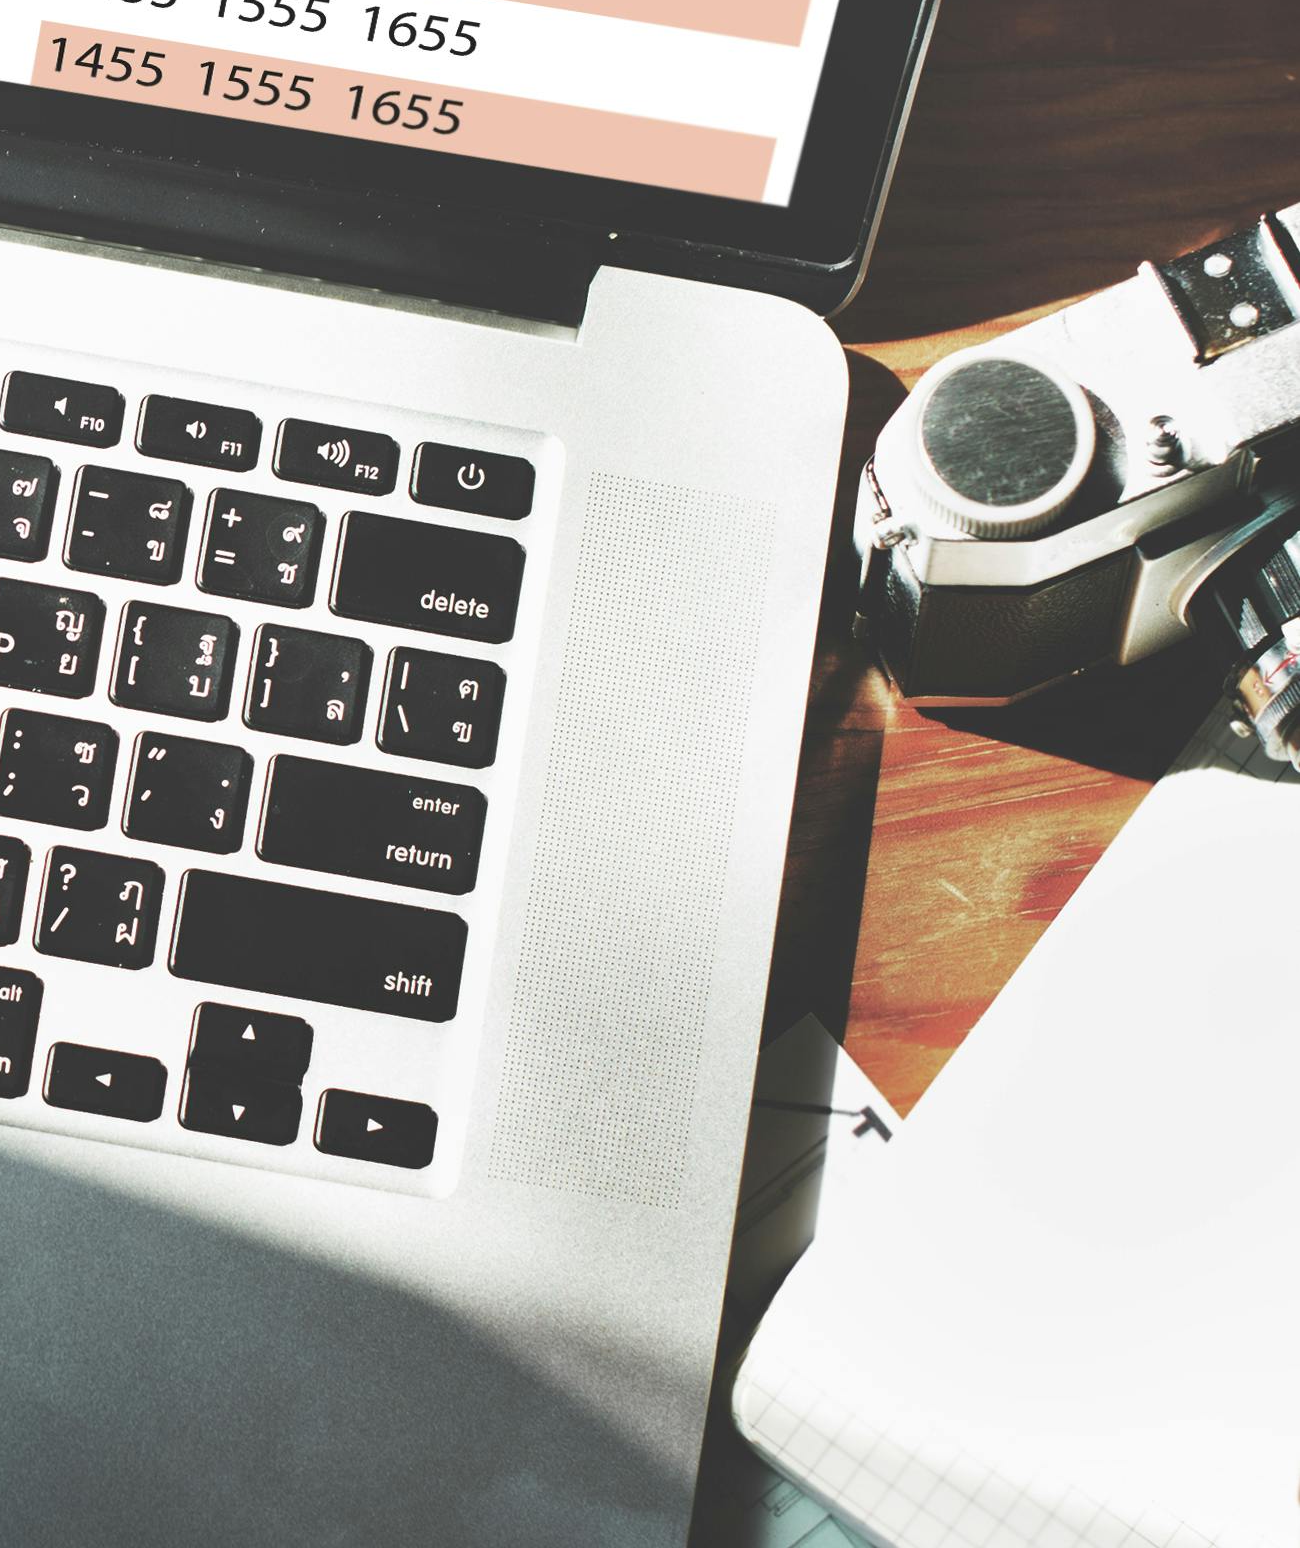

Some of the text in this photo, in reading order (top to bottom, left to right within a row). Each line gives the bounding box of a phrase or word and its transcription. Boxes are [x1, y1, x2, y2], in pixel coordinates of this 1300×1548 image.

[80, 416, 104, 431] F10
[221, 441, 241, 456] F11
[355, 464, 378, 479] F12
[421, 590, 488, 618] delete
[413, 798, 459, 815] enter
[386, 845, 451, 869] return
[384, 972, 432, 996] shift
[0, 985, 22, 1002] alt
